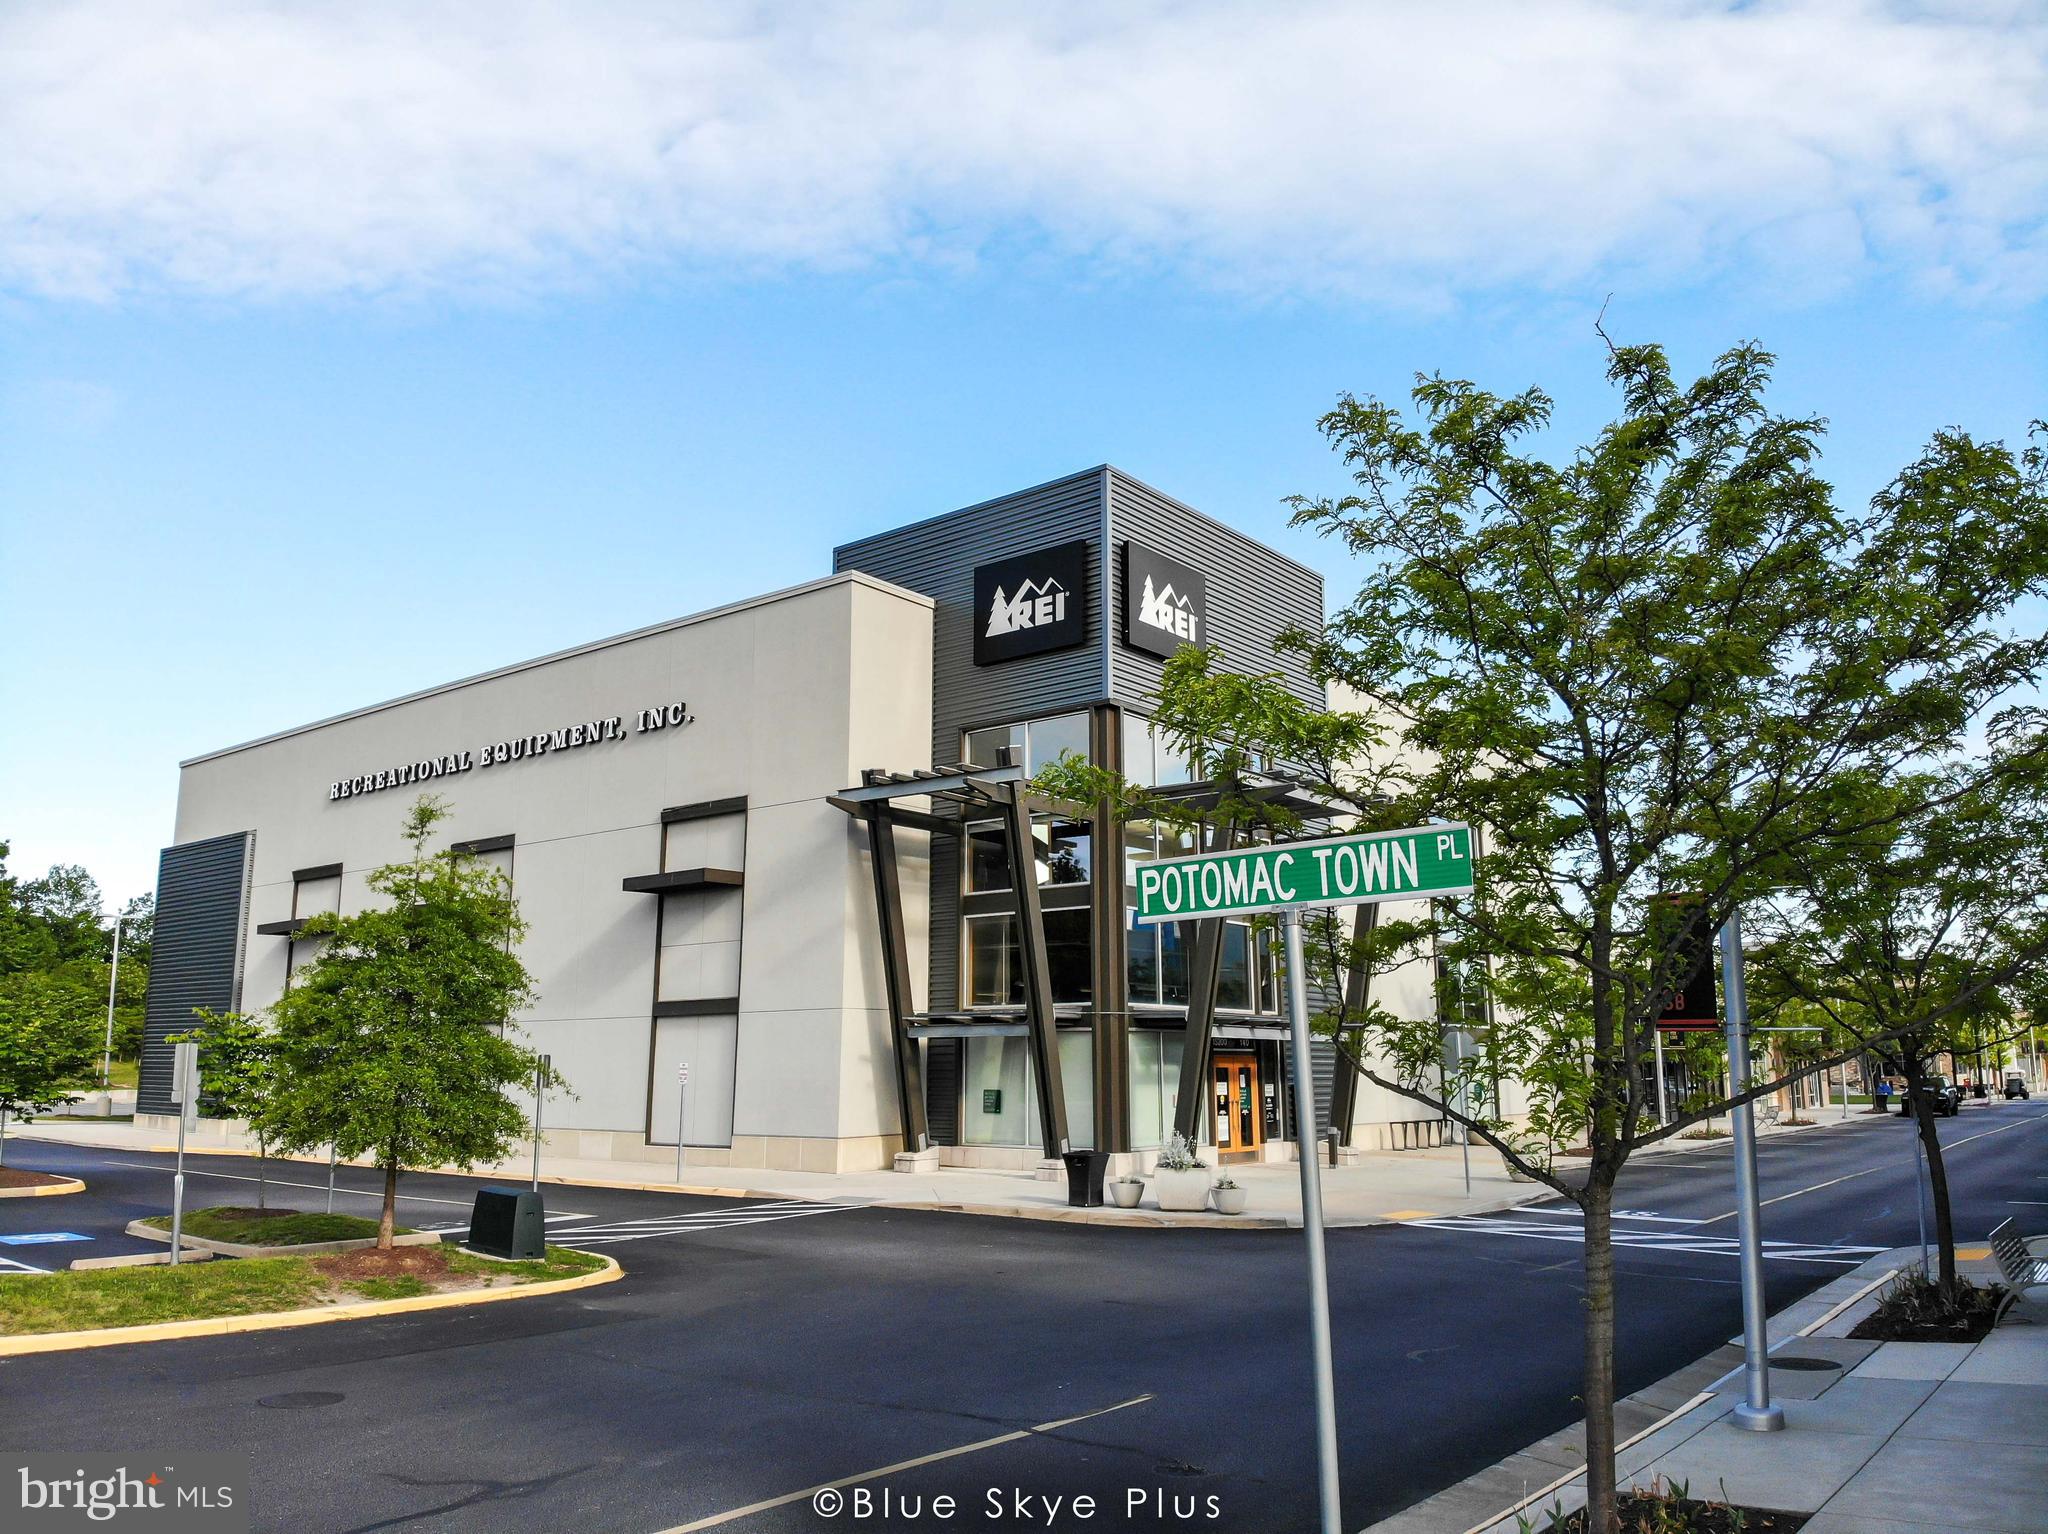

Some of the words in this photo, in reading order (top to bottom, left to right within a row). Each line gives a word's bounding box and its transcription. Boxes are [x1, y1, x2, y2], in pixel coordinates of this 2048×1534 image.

[329, 750, 473, 801] RECREATIONAL
[479, 716, 628, 768] EQUIPMENT,
[637, 701, 696, 733] INC.
[1141, 852, 1297, 914] POTOMAC
[1312, 838, 1419, 897] TOWN
[1436, 834, 1464, 861] PL
